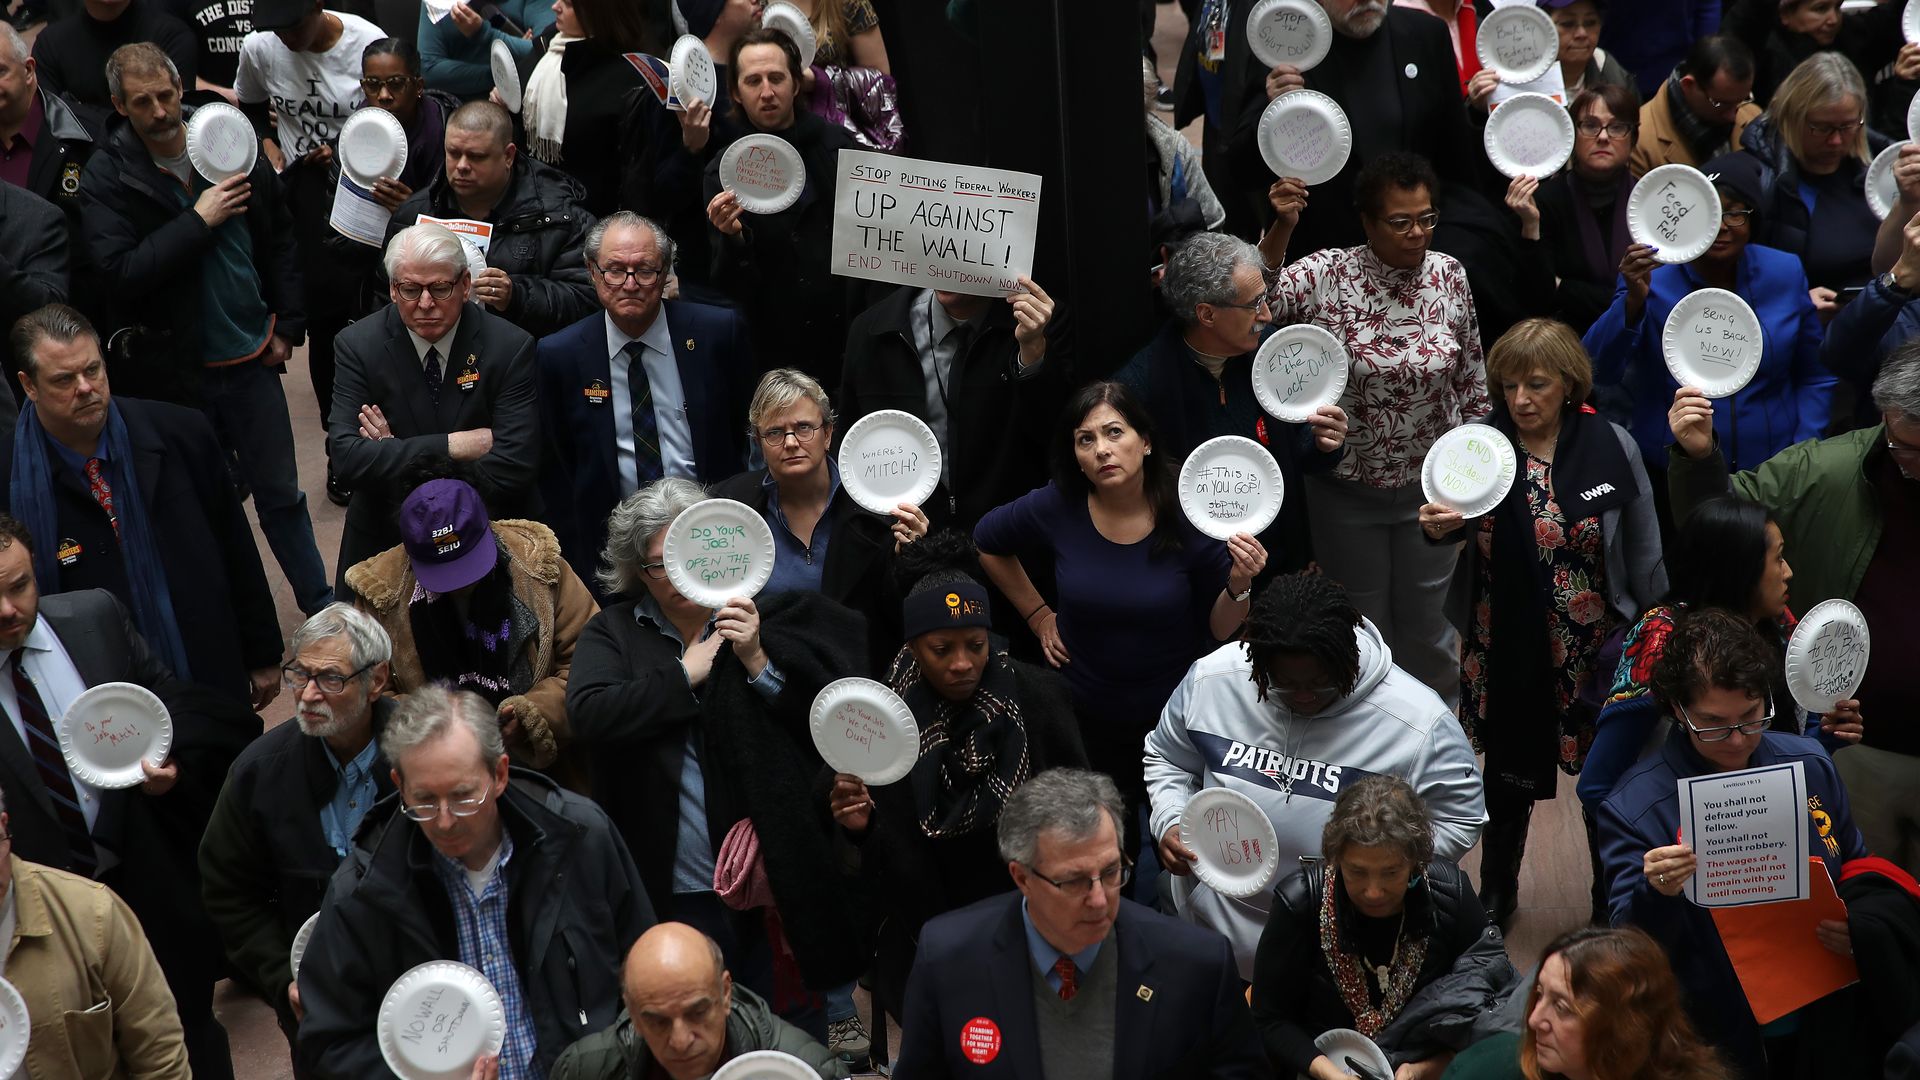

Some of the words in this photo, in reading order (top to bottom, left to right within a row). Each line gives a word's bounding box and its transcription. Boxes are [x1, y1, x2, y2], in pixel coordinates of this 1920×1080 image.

[195, 2, 225, 27] THE
[1274, 10, 1309, 25] STOP
[1259, 26, 1286, 54] SHUT
[306, 78, 322, 97] I
[302, 120, 329, 138] DO
[747, 145, 777, 167] TSA
[850, 164, 892, 182] STOP
[900, 172, 947, 190] PUTTING
[1657, 180, 1697, 218] Feed
[855, 189, 897, 220] UP
[909, 199, 1014, 240] AGAINST
[856, 224, 905, 253] THE
[1656, 219, 1678, 242] Feds
[847, 253, 882, 270] END
[891, 259, 918, 275] THE
[927, 264, 993, 285] SHUTDOWN
[1702, 306, 1735, 327] BRING
[1722, 329, 1749, 343] BACK
[1268, 342, 1303, 373] END
[1700, 341, 1742, 359] NOW!
[862, 445, 904, 460] WHERE'S
[1466, 439, 1491, 464] END
[864, 451, 918, 479] MITCH?
[1196, 465, 1243, 480] #This
[1247, 472, 1258, 482] is
[1196, 483, 1209, 494] on
[1211, 479, 1230, 496] YOU
[1234, 479, 1261, 495] GOP!
[431, 524, 454, 538] 32BJ
[690, 527, 712, 539] DO
[714, 525, 747, 538] YOUR
[437, 540, 461, 555] SEIU
[701, 535, 736, 551] JOB!
[686, 556, 722, 571] OPEN
[727, 553, 751, 564] THE
[700, 564, 748, 585] GOV'T!
[1816, 619, 1835, 641] I
[1834, 622, 1861, 639] WANT
[836, 710, 846, 721] So
[1221, 740, 1343, 794] PATRIOTS
[1722, 781, 1746, 789] Leviticus
[1704, 801, 1722, 810] You
[1724, 796, 1747, 808] shall
[1749, 794, 1767, 804] not
[1807, 794, 1823, 810] GE
[1203, 807, 1239, 840] PAY
[1704, 808, 1743, 822] defraud
[1745, 807, 1768, 818] your
[1705, 822, 1738, 833] fellow.
[1706, 838, 1724, 846] You
[1726, 833, 1749, 844] shall
[1751, 831, 1768, 840] not
[1218, 838, 1263, 866] US!!
[1706, 845, 1743, 856] commit
[1745, 841, 1787, 852] robbery.
[1706, 860, 1725, 869] The
[1726, 857, 1757, 867] wages
[1759, 853, 1770, 862] of
[1706, 869, 1742, 879] laborer
[1744, 865, 1767, 874] shall
[1769, 863, 1787, 871] not
[1706, 878, 1741, 889] remain
[1743, 875, 1765, 885] with
[1767, 874, 1786, 883] you
[1706, 889, 1730, 899] until
[1731, 885, 1777, 895] morning.
[401, 1019, 426, 1046] NO
[414, 987, 446, 1019] WALL
[432, 1012, 449, 1033] OR
